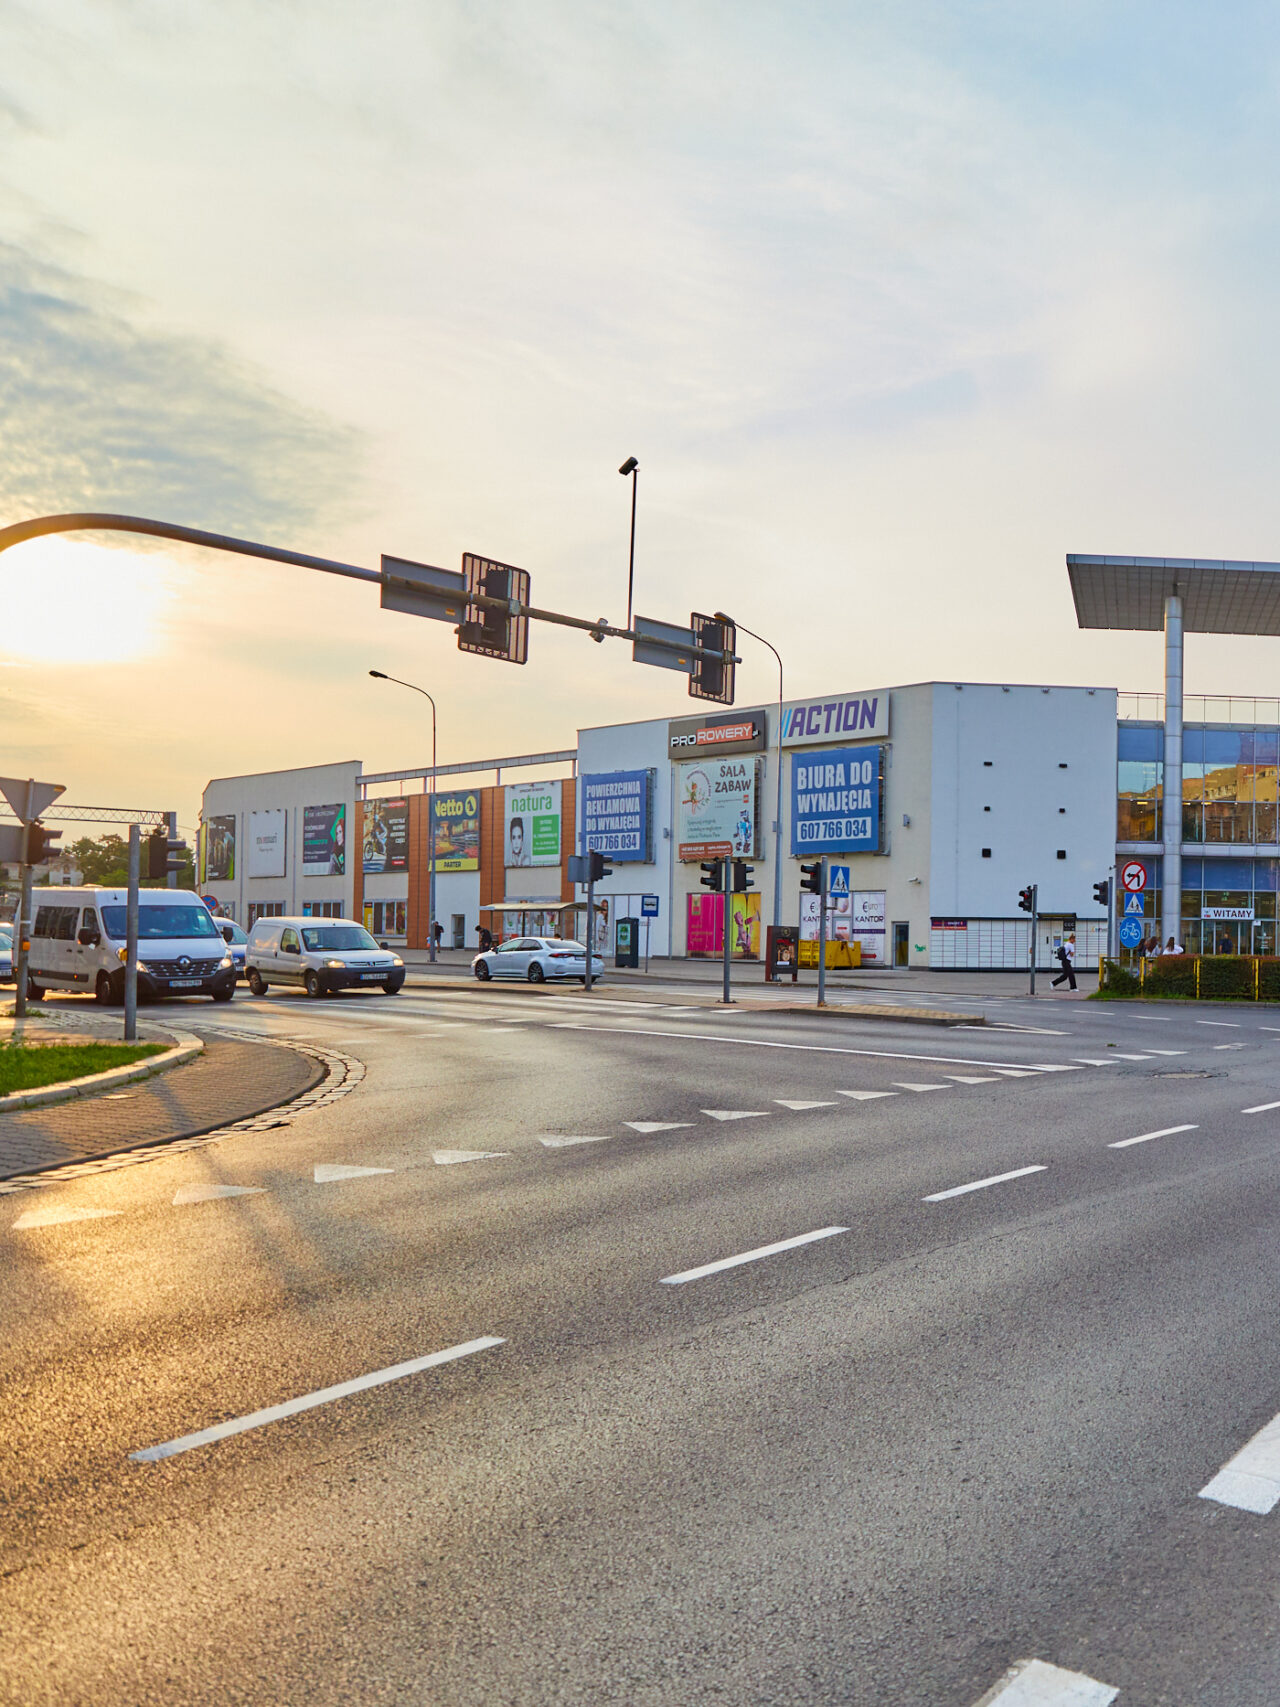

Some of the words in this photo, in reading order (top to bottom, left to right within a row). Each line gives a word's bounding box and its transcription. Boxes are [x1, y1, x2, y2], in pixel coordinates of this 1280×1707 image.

[788, 698, 878, 738] ACTION
[720, 764, 746, 778] SALA
[797, 763, 846, 790] BIURA
[850, 760, 873, 786] DO
[586, 781, 641, 798] POWIERZCHNIA
[715, 779, 752, 793] ZABAW
[512, 794, 553, 813] natura
[586, 797, 641, 816] REKLAMOWA
[797, 789, 872, 814] WYNAJĘCIA
[586, 817, 597, 832] DO
[598, 815, 641, 831] WYNAJĘCIA
[800, 822, 823, 840] 607
[822, 820, 843, 839] 766
[845, 819, 867, 838] 034
[588, 836, 603, 850] 607
[605, 834, 619, 850] 766
[621, 833, 637, 849] 034
[855, 915, 885, 923] KANTOR
[1213, 909, 1252, 918] WITAMY
